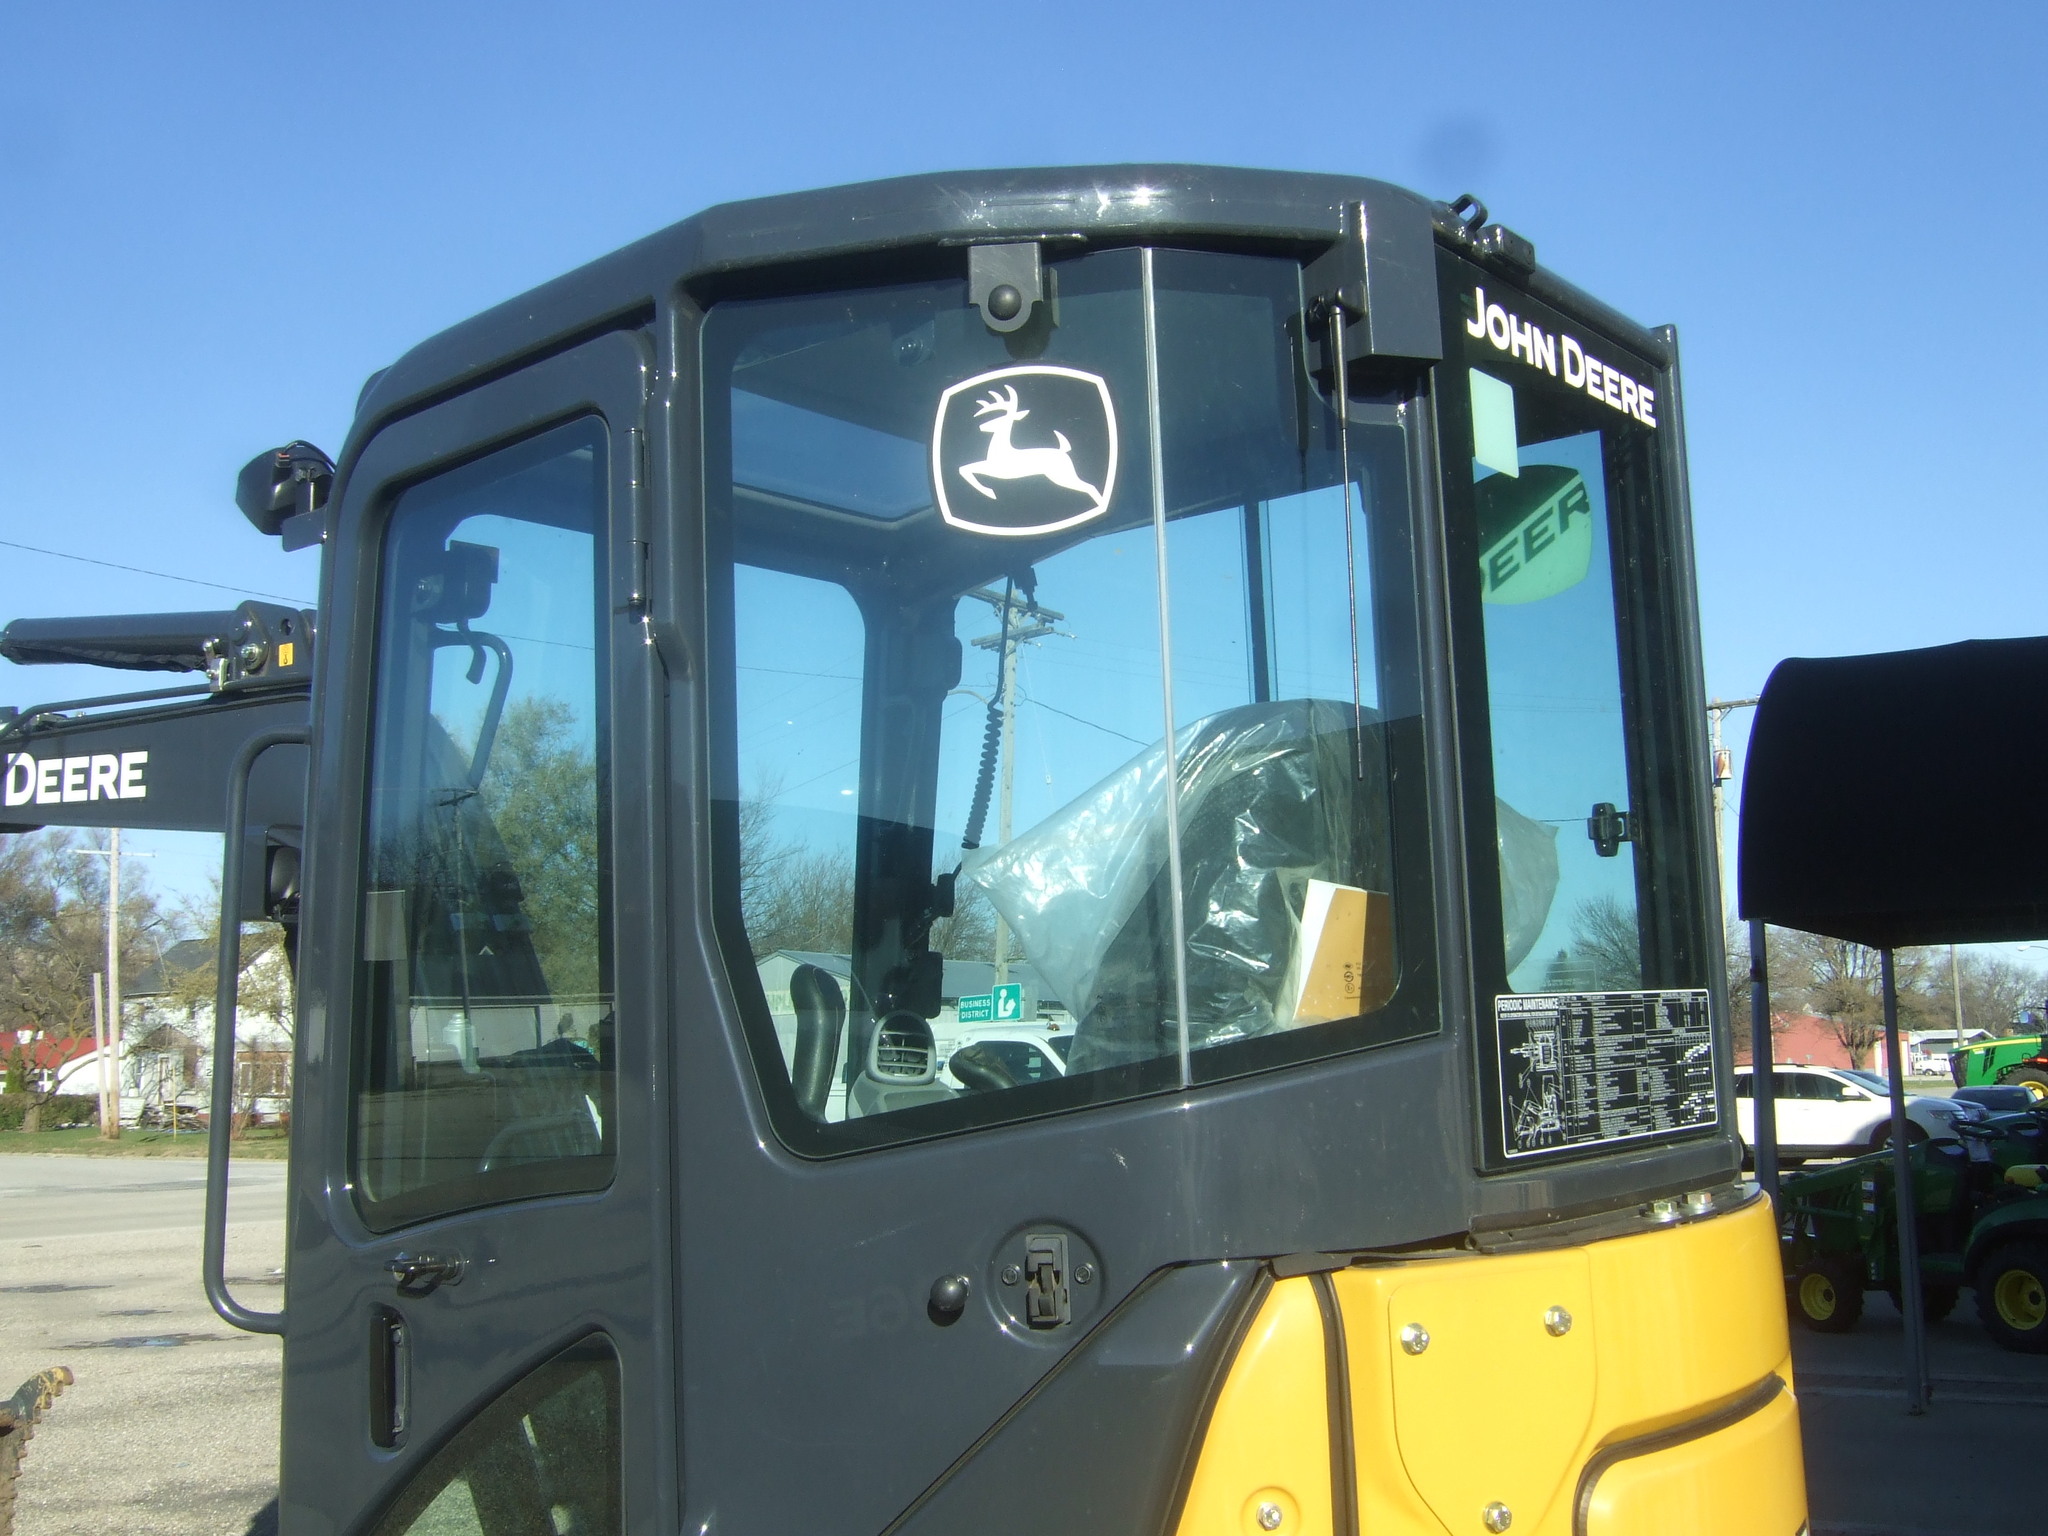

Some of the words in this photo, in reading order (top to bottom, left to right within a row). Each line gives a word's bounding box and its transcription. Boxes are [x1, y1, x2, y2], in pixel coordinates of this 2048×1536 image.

[1466, 286, 1558, 377] JOHN
[1562, 333, 1658, 430] DEERE
[1482, 481, 1591, 592] EER
[4, 750, 149, 807] DEERE
[960, 998, 991, 1009] BUSINESS
[961, 1009, 990, 1019] DISTRICT
[1497, 998, 1523, 1012] PERIODIC
[1523, 997, 1559, 1011] MAINTENANCE
